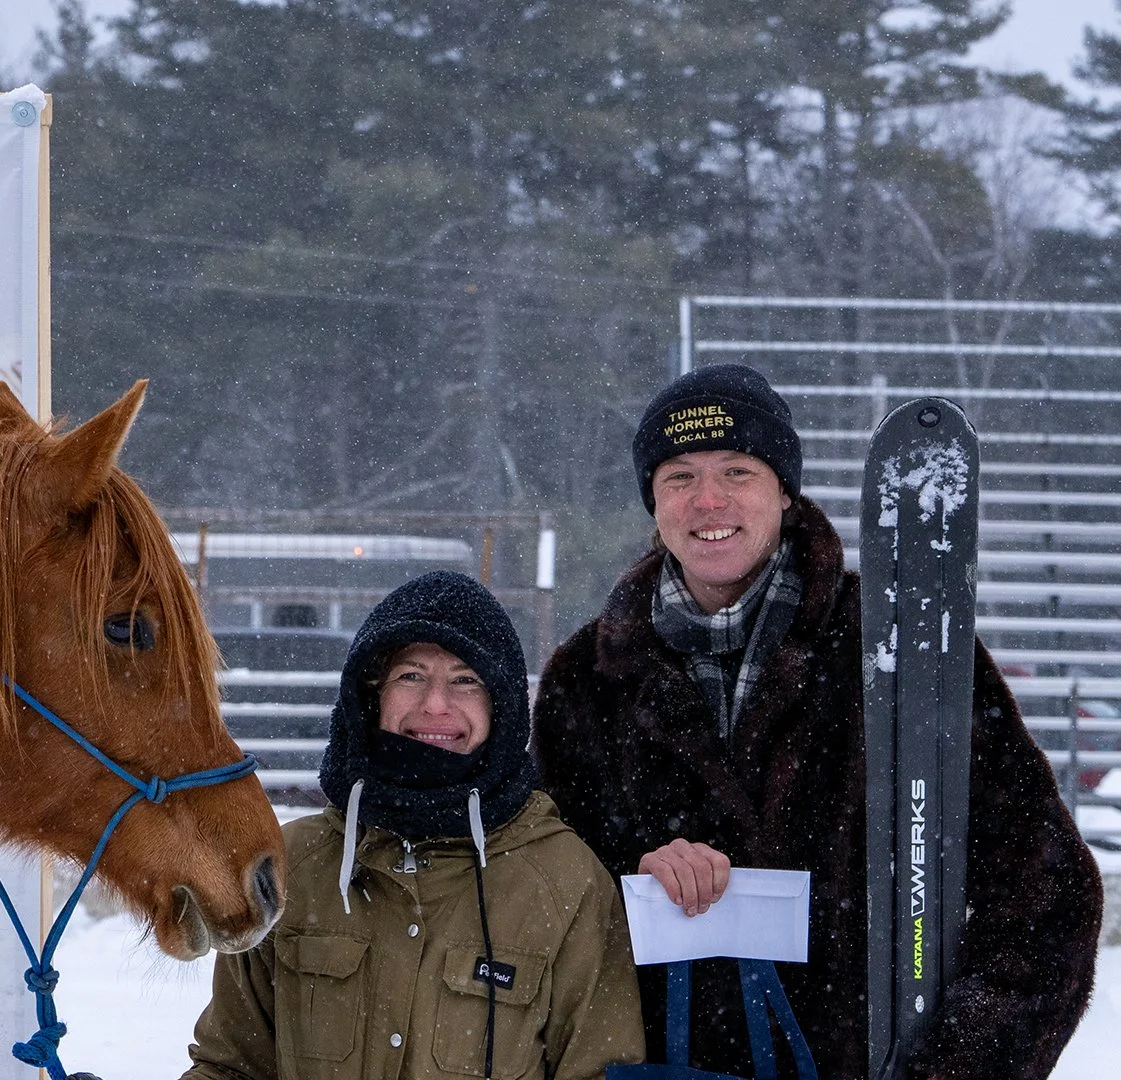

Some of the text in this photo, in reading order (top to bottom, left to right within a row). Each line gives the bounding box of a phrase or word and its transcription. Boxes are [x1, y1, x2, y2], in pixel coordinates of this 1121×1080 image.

[669, 406, 727, 422] TUNNEL
[664, 416, 734, 436] WORKERS
[673, 429, 725, 445] LOCAL 88
[914, 917, 923, 979] KATANA
